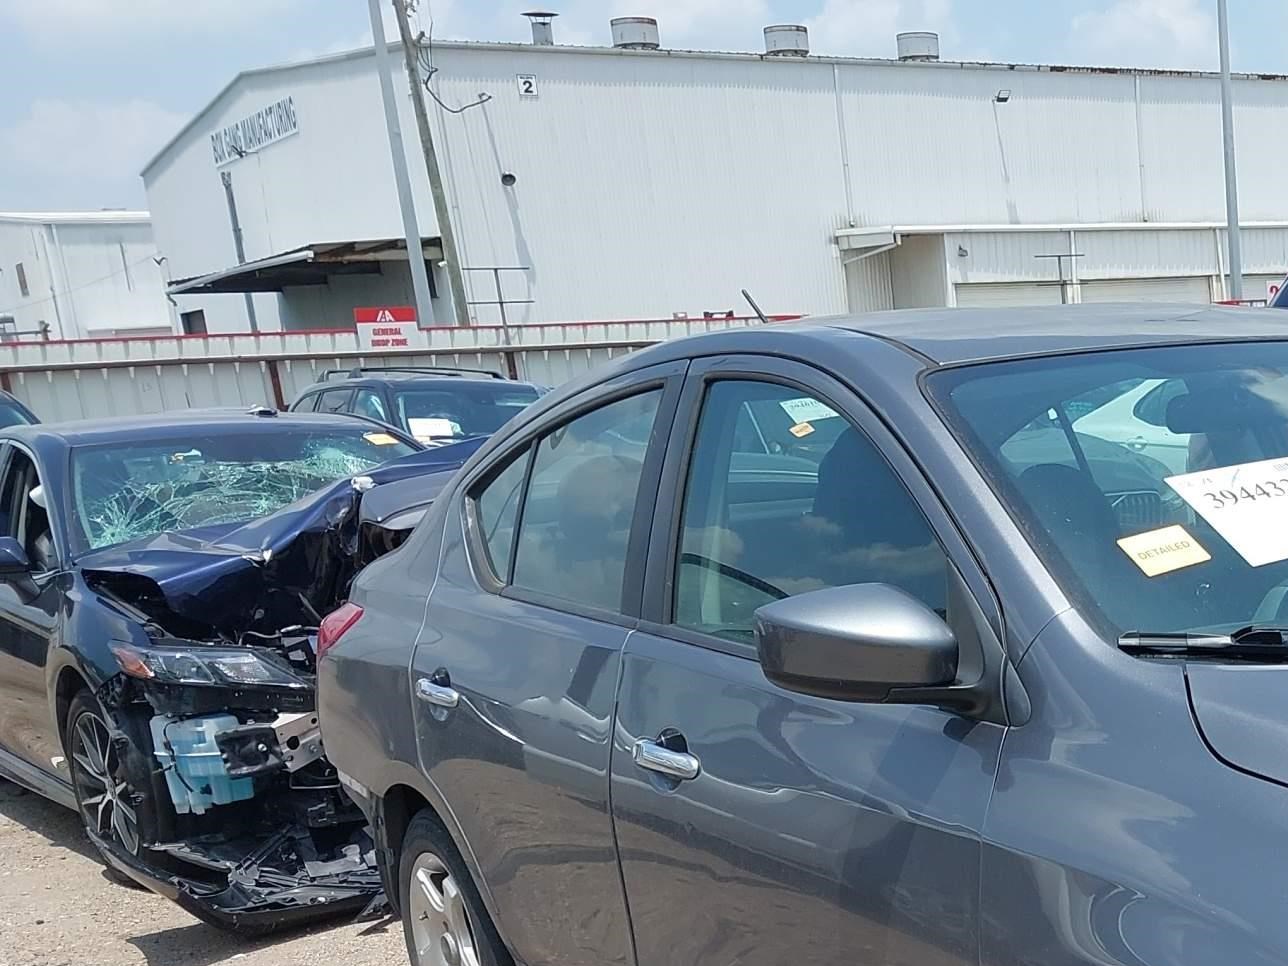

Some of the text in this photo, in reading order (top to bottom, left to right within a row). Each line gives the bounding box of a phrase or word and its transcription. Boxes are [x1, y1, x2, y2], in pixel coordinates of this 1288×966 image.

[522, 80, 534, 93] 2
[372, 327, 402, 336] GENERAL
[1137, 540, 1191, 561] DETAILED
